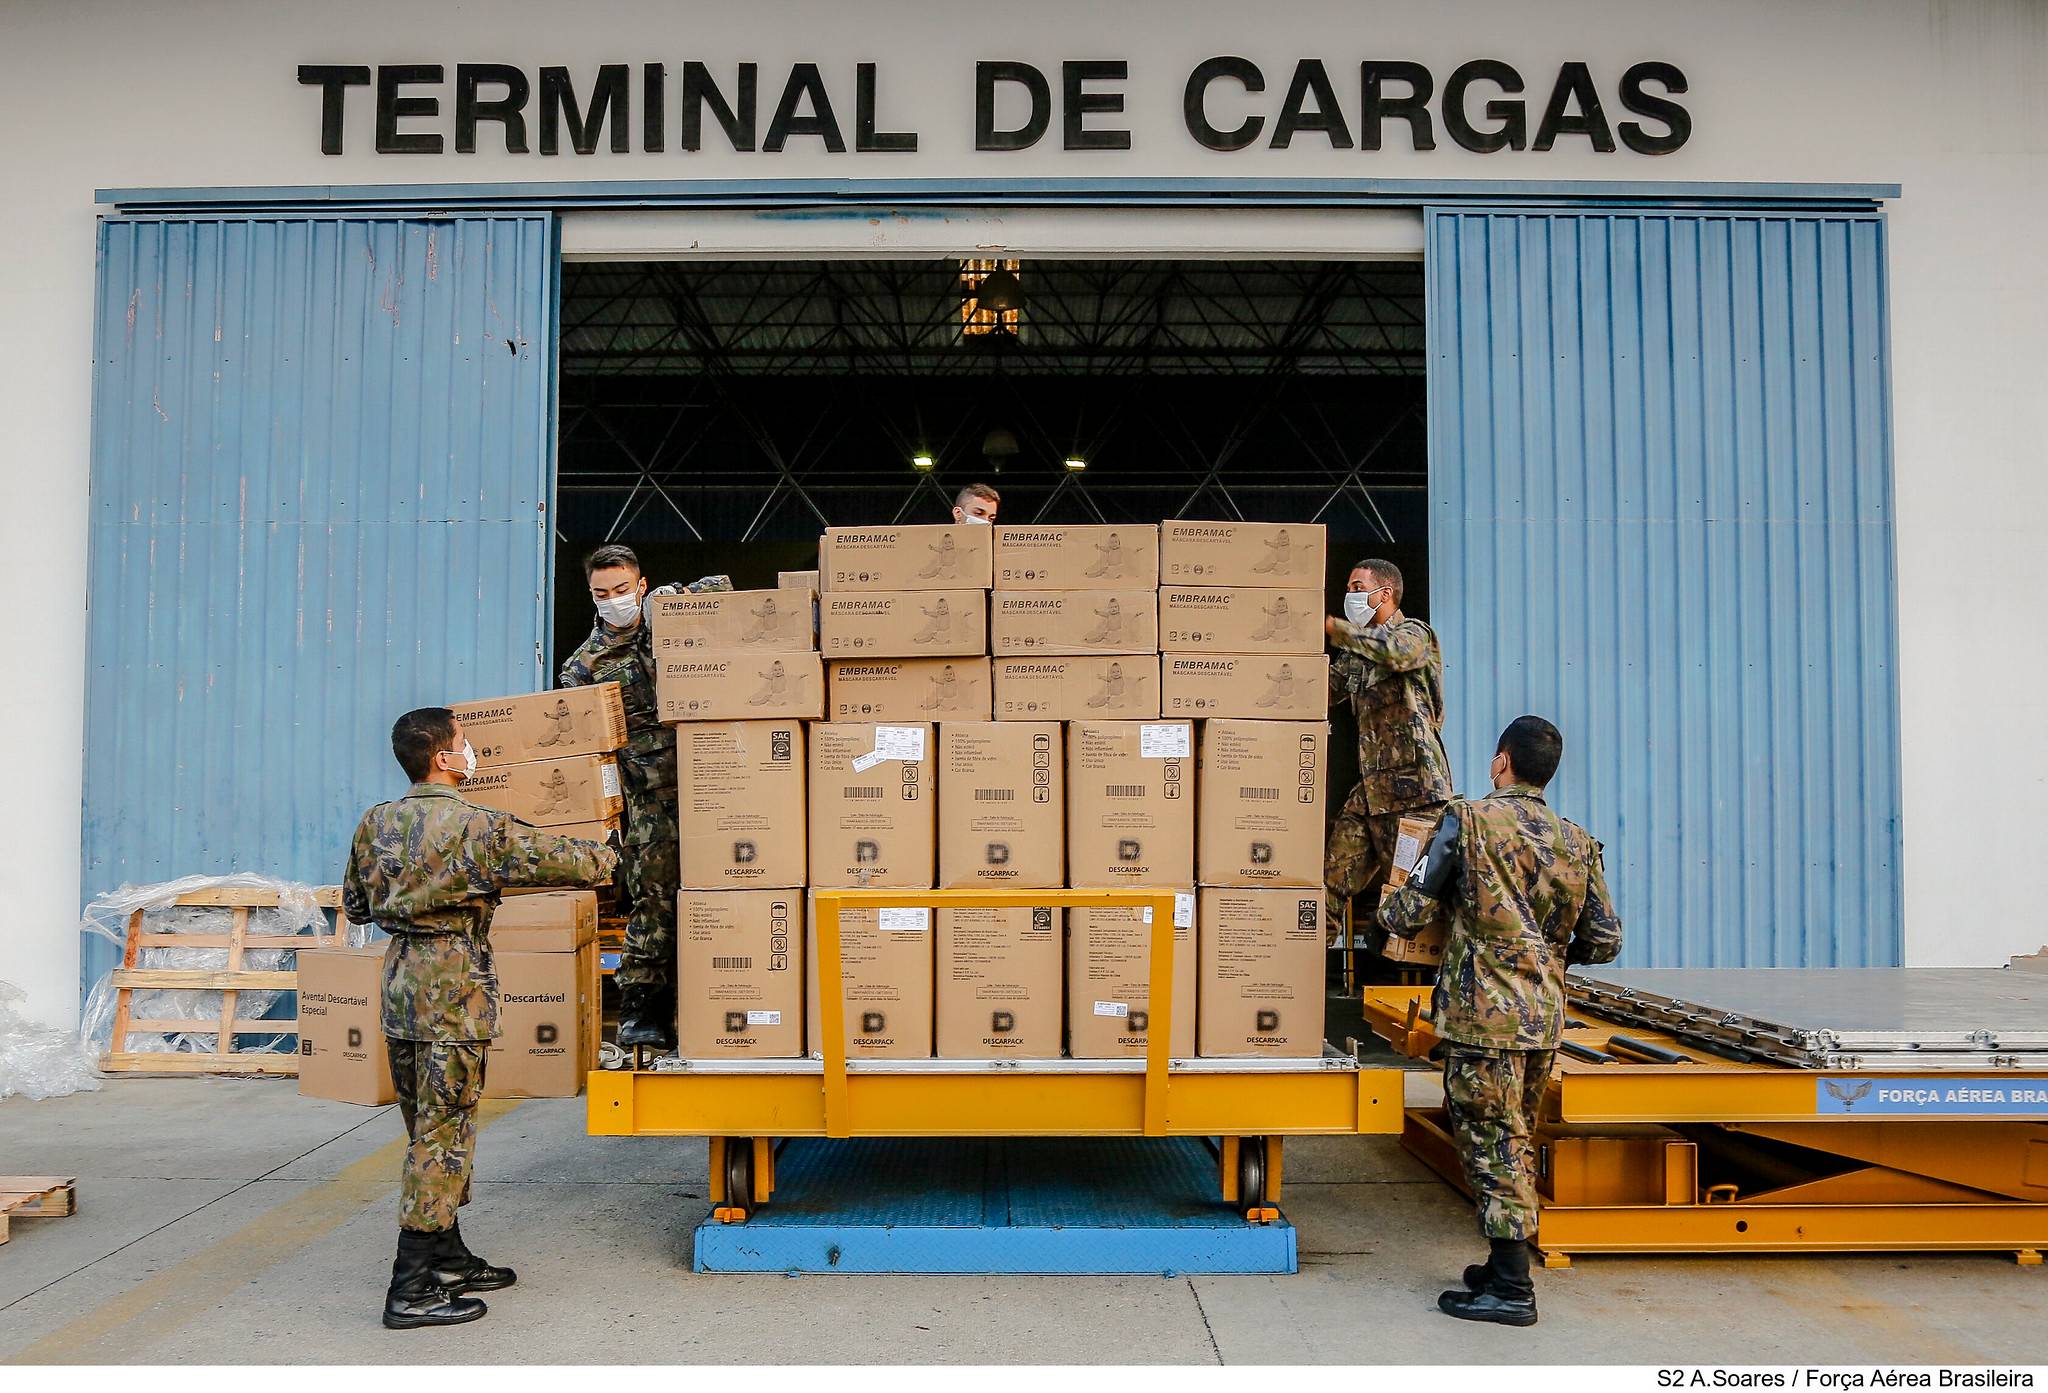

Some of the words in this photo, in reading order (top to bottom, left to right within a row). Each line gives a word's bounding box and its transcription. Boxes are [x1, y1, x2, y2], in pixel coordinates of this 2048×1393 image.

[297, 61, 919, 155] TERMINAL
[974, 60, 1132, 151] DE
[1183, 57, 1693, 155] CARGAS
[1004, 533, 1062, 541] EMBRAMAC
[1173, 528, 1232, 537] EMBRAMAC
[836, 534, 896, 543] EMBRAMAC
[1003, 600, 1062, 608] EMBRAMAC
[1170, 594, 1230, 604] EMBRAMAC
[662, 601, 720, 610] EMBRAMAC
[832, 601, 891, 610] EMBRAMAC
[667, 664, 726, 672] EMBRAMAC
[1006, 665, 1064, 673] EMBRAMAC
[1174, 661, 1234, 670] EMBRAMAC
[839, 666, 898, 676] EMBRAMAC
[456, 708, 513, 721] EMBRAMAC
[456, 774, 507, 787] MBRAMAC
[1409, 855, 1429, 884] A
[302, 991, 326, 1002] Avental
[328, 994, 368, 1006] Descartável
[504, 993, 565, 1003] Descartável
[302, 1005, 327, 1016] Especial
[1879, 1089, 1939, 1106] FORÇA
[1945, 1087, 2005, 1103] AÉREA
